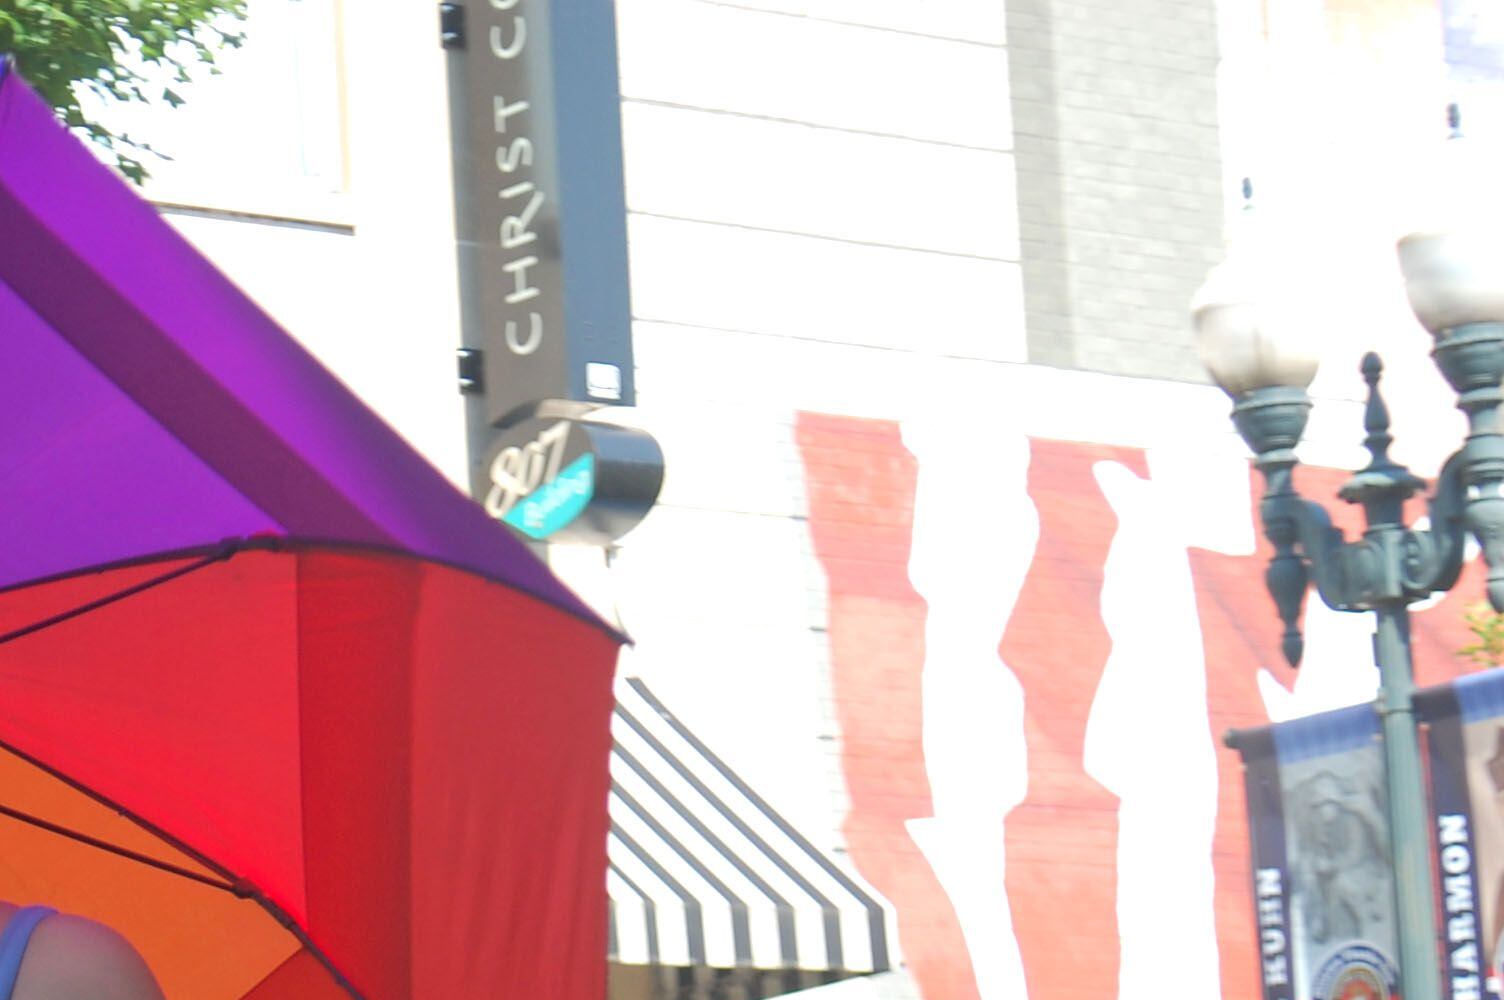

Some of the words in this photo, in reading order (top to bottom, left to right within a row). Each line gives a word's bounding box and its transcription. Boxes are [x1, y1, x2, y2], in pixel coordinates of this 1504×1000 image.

[489, 0, 527, 60] C
[493, 96, 543, 355] CHRIST
[484, 420, 572, 520] 807
[1256, 867, 1288, 985] KUHN
